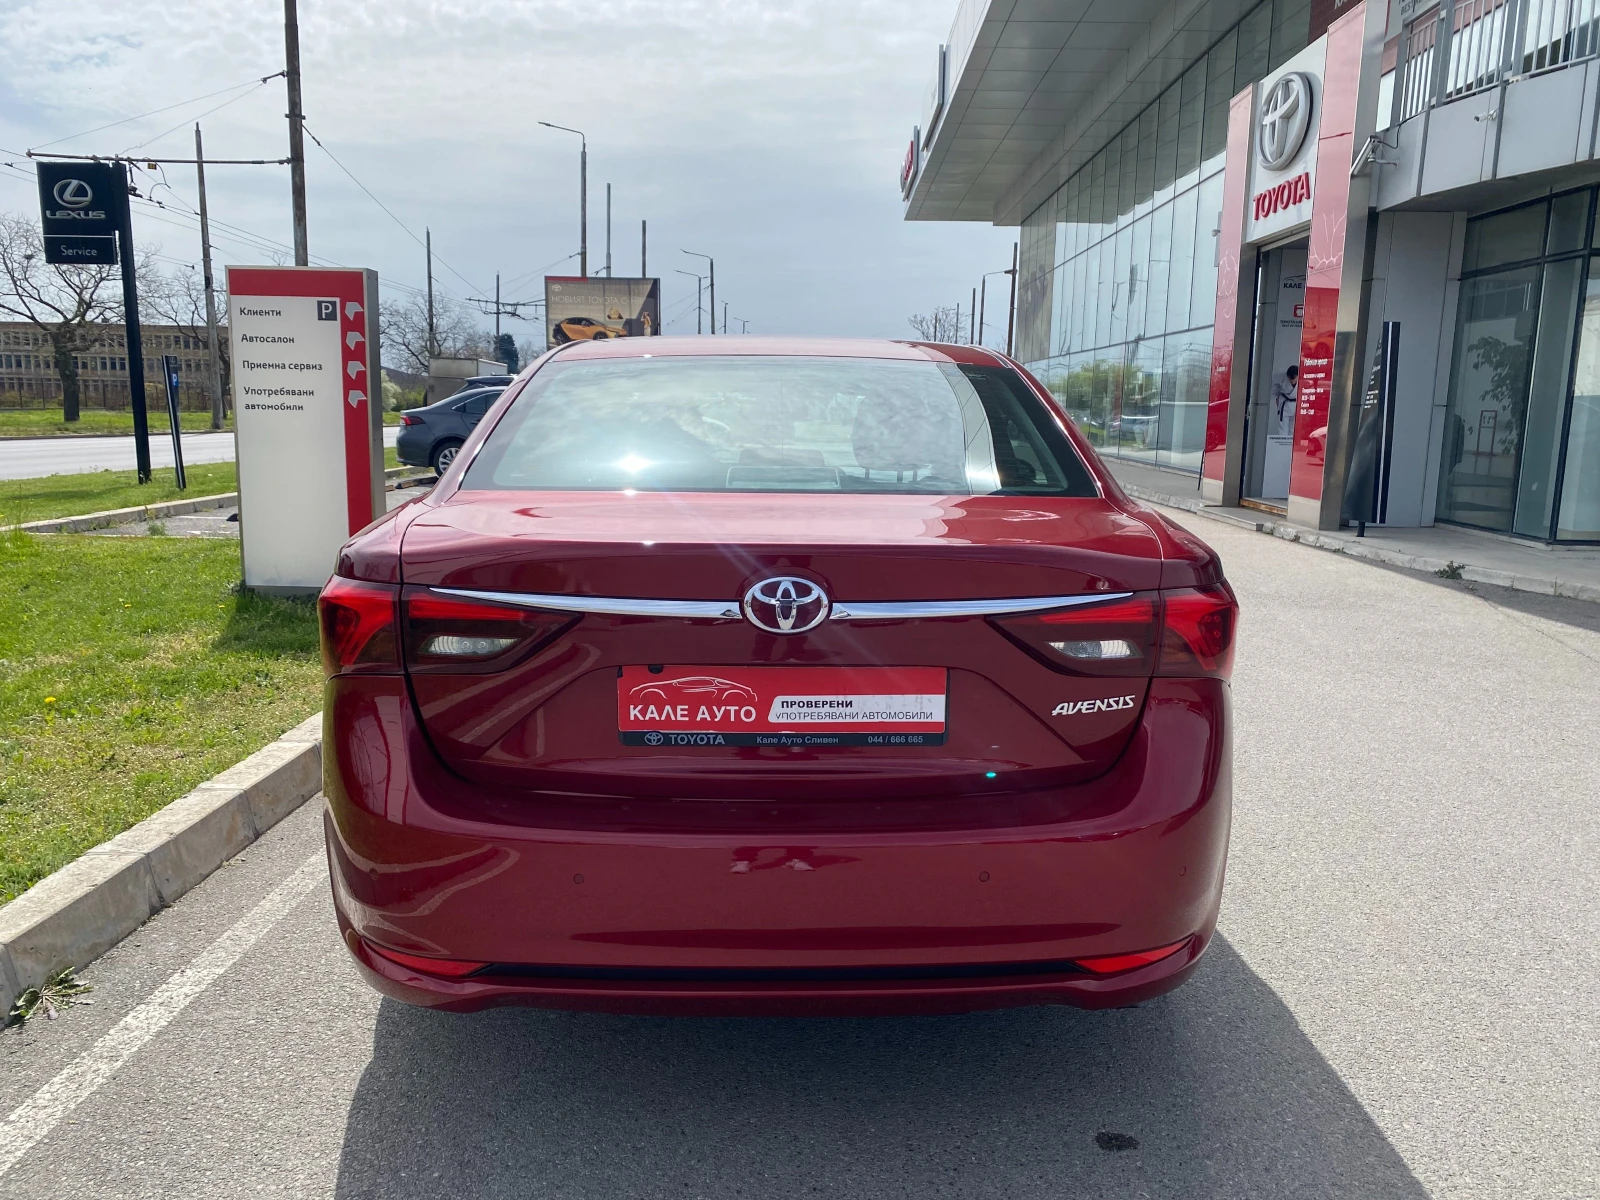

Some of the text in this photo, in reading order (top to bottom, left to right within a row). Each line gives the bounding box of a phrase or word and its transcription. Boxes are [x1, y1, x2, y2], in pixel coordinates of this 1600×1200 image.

[1253, 172, 1310, 221] TOYOTA
[46, 210, 106, 219] LEXUS
[60, 245, 98, 256] Service
[588, 296, 618, 304] TOYOTA
[239, 307, 282, 317] Клиенти
[241, 333, 295, 344] Автосалон
[242, 360, 323, 372] Приемна сервиз
[243, 386, 315, 397] Употребявани
[244, 402, 304, 411] автомобили
[781, 700, 853, 709] ПРОВЕРЕНИ
[1051, 695, 1136, 716] AVENSIS
[629, 704, 757, 722] КАЛЕ АУТО
[775, 711, 933, 721] УПОТРЕБЯВАНИ АВТОМОБИЛИ
[669, 734, 726, 745] TOYOTA
[756, 735, 839, 746] Кале Ауто Сливен
[868, 736, 883, 744] 044
[890, 736, 906, 744] 666
[907, 735, 924, 744] 665
